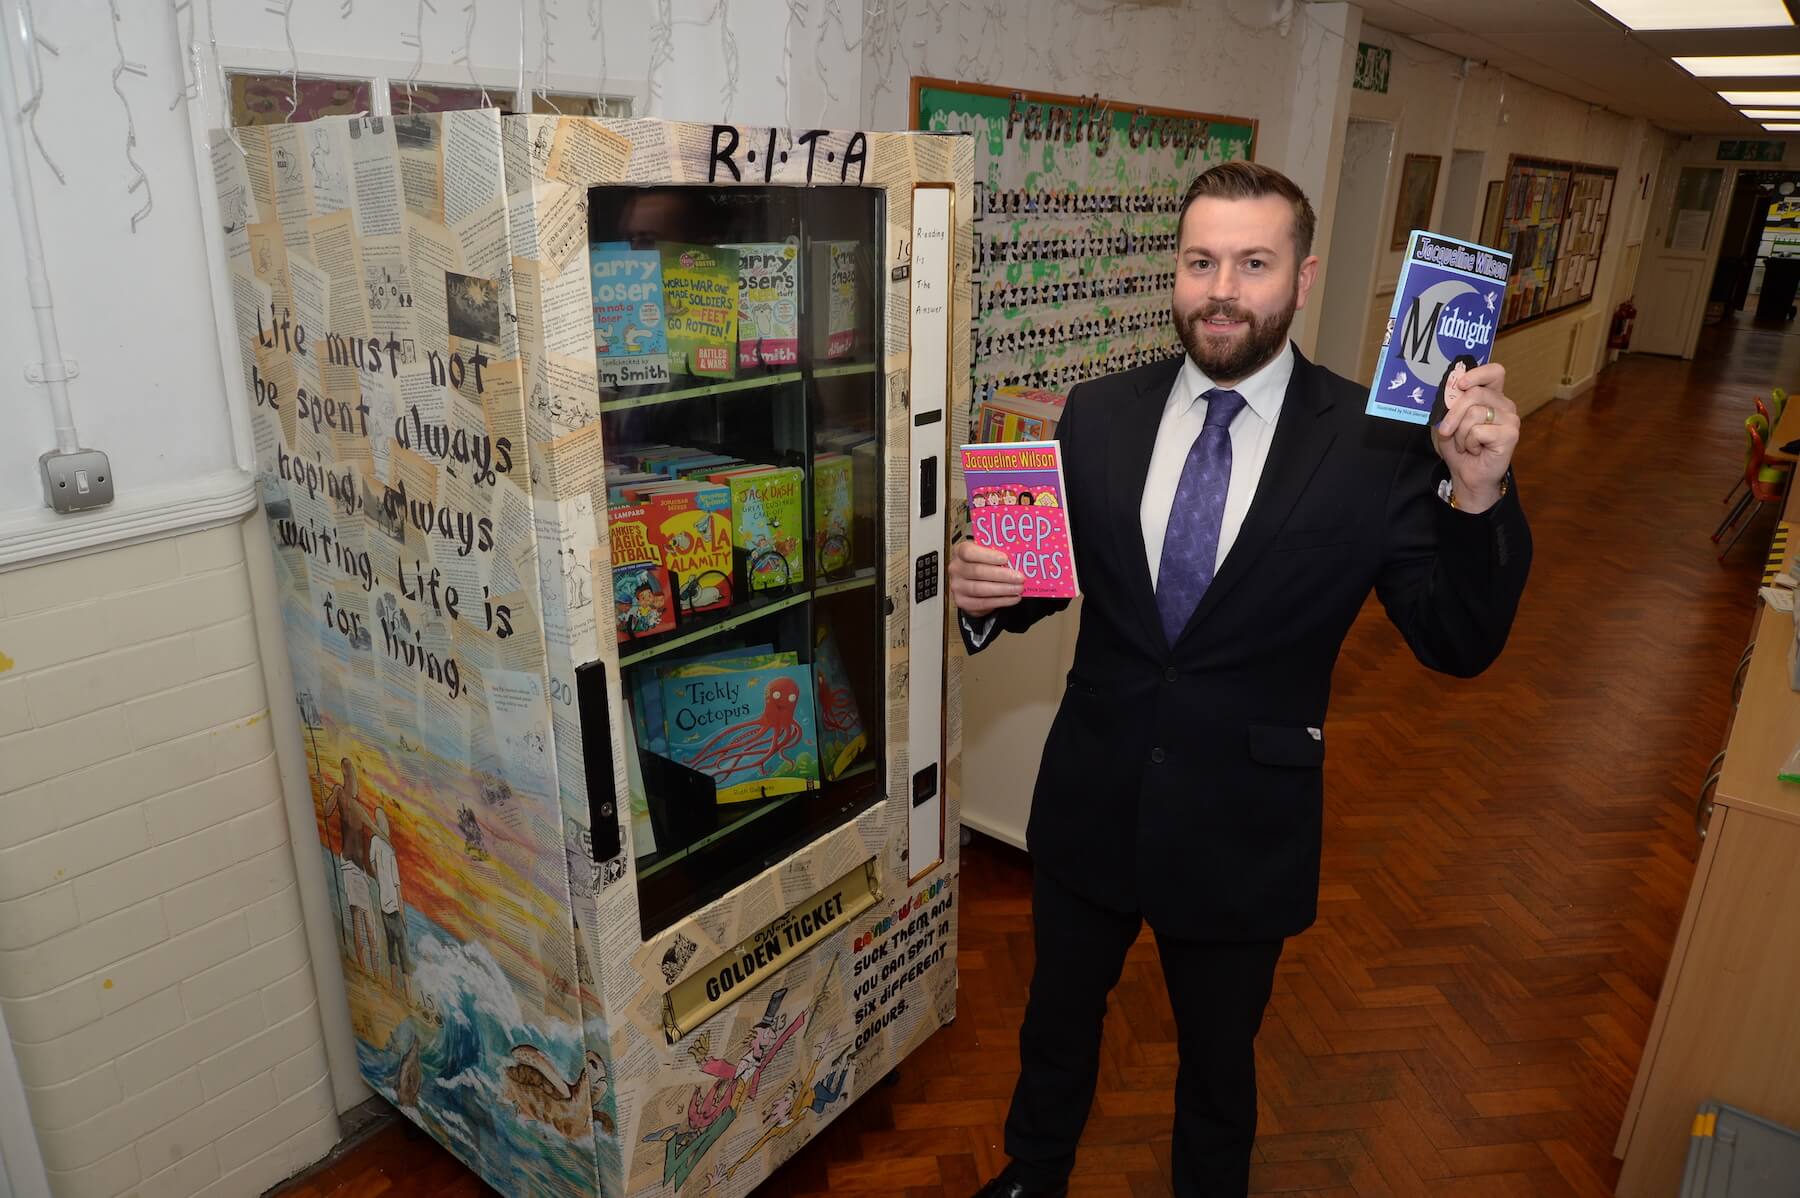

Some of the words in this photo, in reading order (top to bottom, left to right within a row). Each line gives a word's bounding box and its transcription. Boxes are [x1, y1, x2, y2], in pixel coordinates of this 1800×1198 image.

[1005, 92, 1113, 158] Family
[592, 259, 657, 280] arry
[739, 253, 793, 273] arry
[1416, 237, 1476, 272] Jacqueline
[1475, 252, 1508, 281] Wilson
[663, 278, 689, 289] WORLD
[690, 280, 713, 293] WAR
[738, 272, 794, 290] oser's
[592, 282, 658, 303] oser
[669, 290, 689, 299] MADE
[607, 303, 625, 312] not
[701, 309, 729, 324] FEET
[668, 316, 682, 331] GO
[1396, 295, 1492, 365] Midnight
[256, 303, 306, 356] Life
[325, 330, 402, 379] must
[427, 344, 489, 394] not
[699, 348, 727, 359] BATTLES
[599, 369, 618, 383] im
[620, 365, 668, 382] Smith
[706, 360, 727, 369] WARS
[252, 365, 280, 410] be
[296, 387, 370, 437] spent
[394, 404, 513, 487] always
[965, 452, 1018, 471] Jacqueline
[1019, 452, 1055, 468] Wilson
[739, 487, 769, 503] JACK
[771, 483, 794, 498] DASH
[383, 480, 494, 556] always
[614, 509, 645, 520] LAMPARD
[609, 525, 641, 538] ANKIE'S
[674, 513, 731, 556] OALA
[611, 547, 660, 566] OTBALL
[671, 552, 731, 573] ALAMITY
[1007, 551, 1064, 580] vers
[398, 557, 459, 619] Life
[484, 586, 513, 639] is
[323, 592, 361, 639] for
[551, 677, 572, 706] 20
[685, 681, 740, 706] Tickly
[676, 702, 750, 731] Octopus
[706, 935, 781, 1002] GOLDEN
[783, 892, 843, 947] TICKET
[854, 940, 888, 977] SUCK
[854, 973, 878, 1001] YOU
